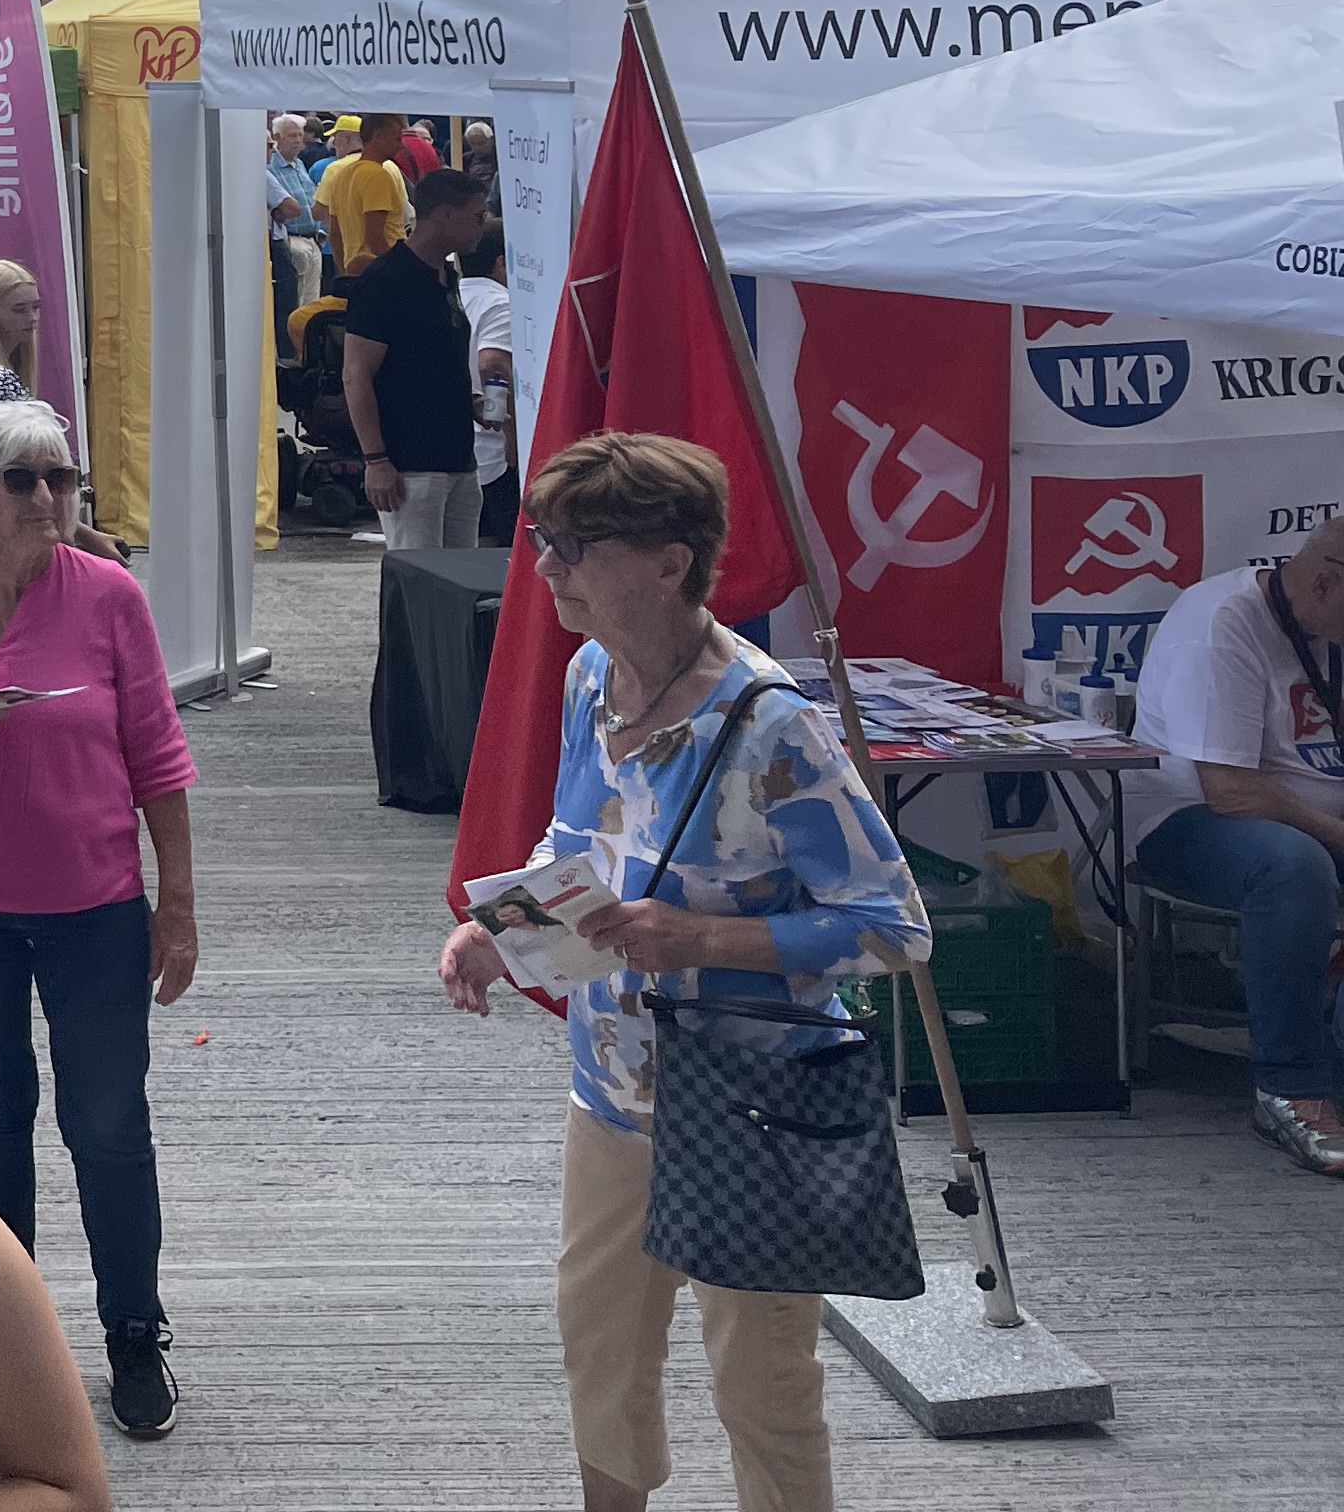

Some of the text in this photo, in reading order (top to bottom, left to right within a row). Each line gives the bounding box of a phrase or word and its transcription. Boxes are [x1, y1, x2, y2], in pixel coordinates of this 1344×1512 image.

[231, 0, 506, 68] www.mentalhelse.no
[1057, 354, 1175, 409] NKP
[1266, 502, 1340, 535] DET
[1062, 624, 1159, 671] NK
